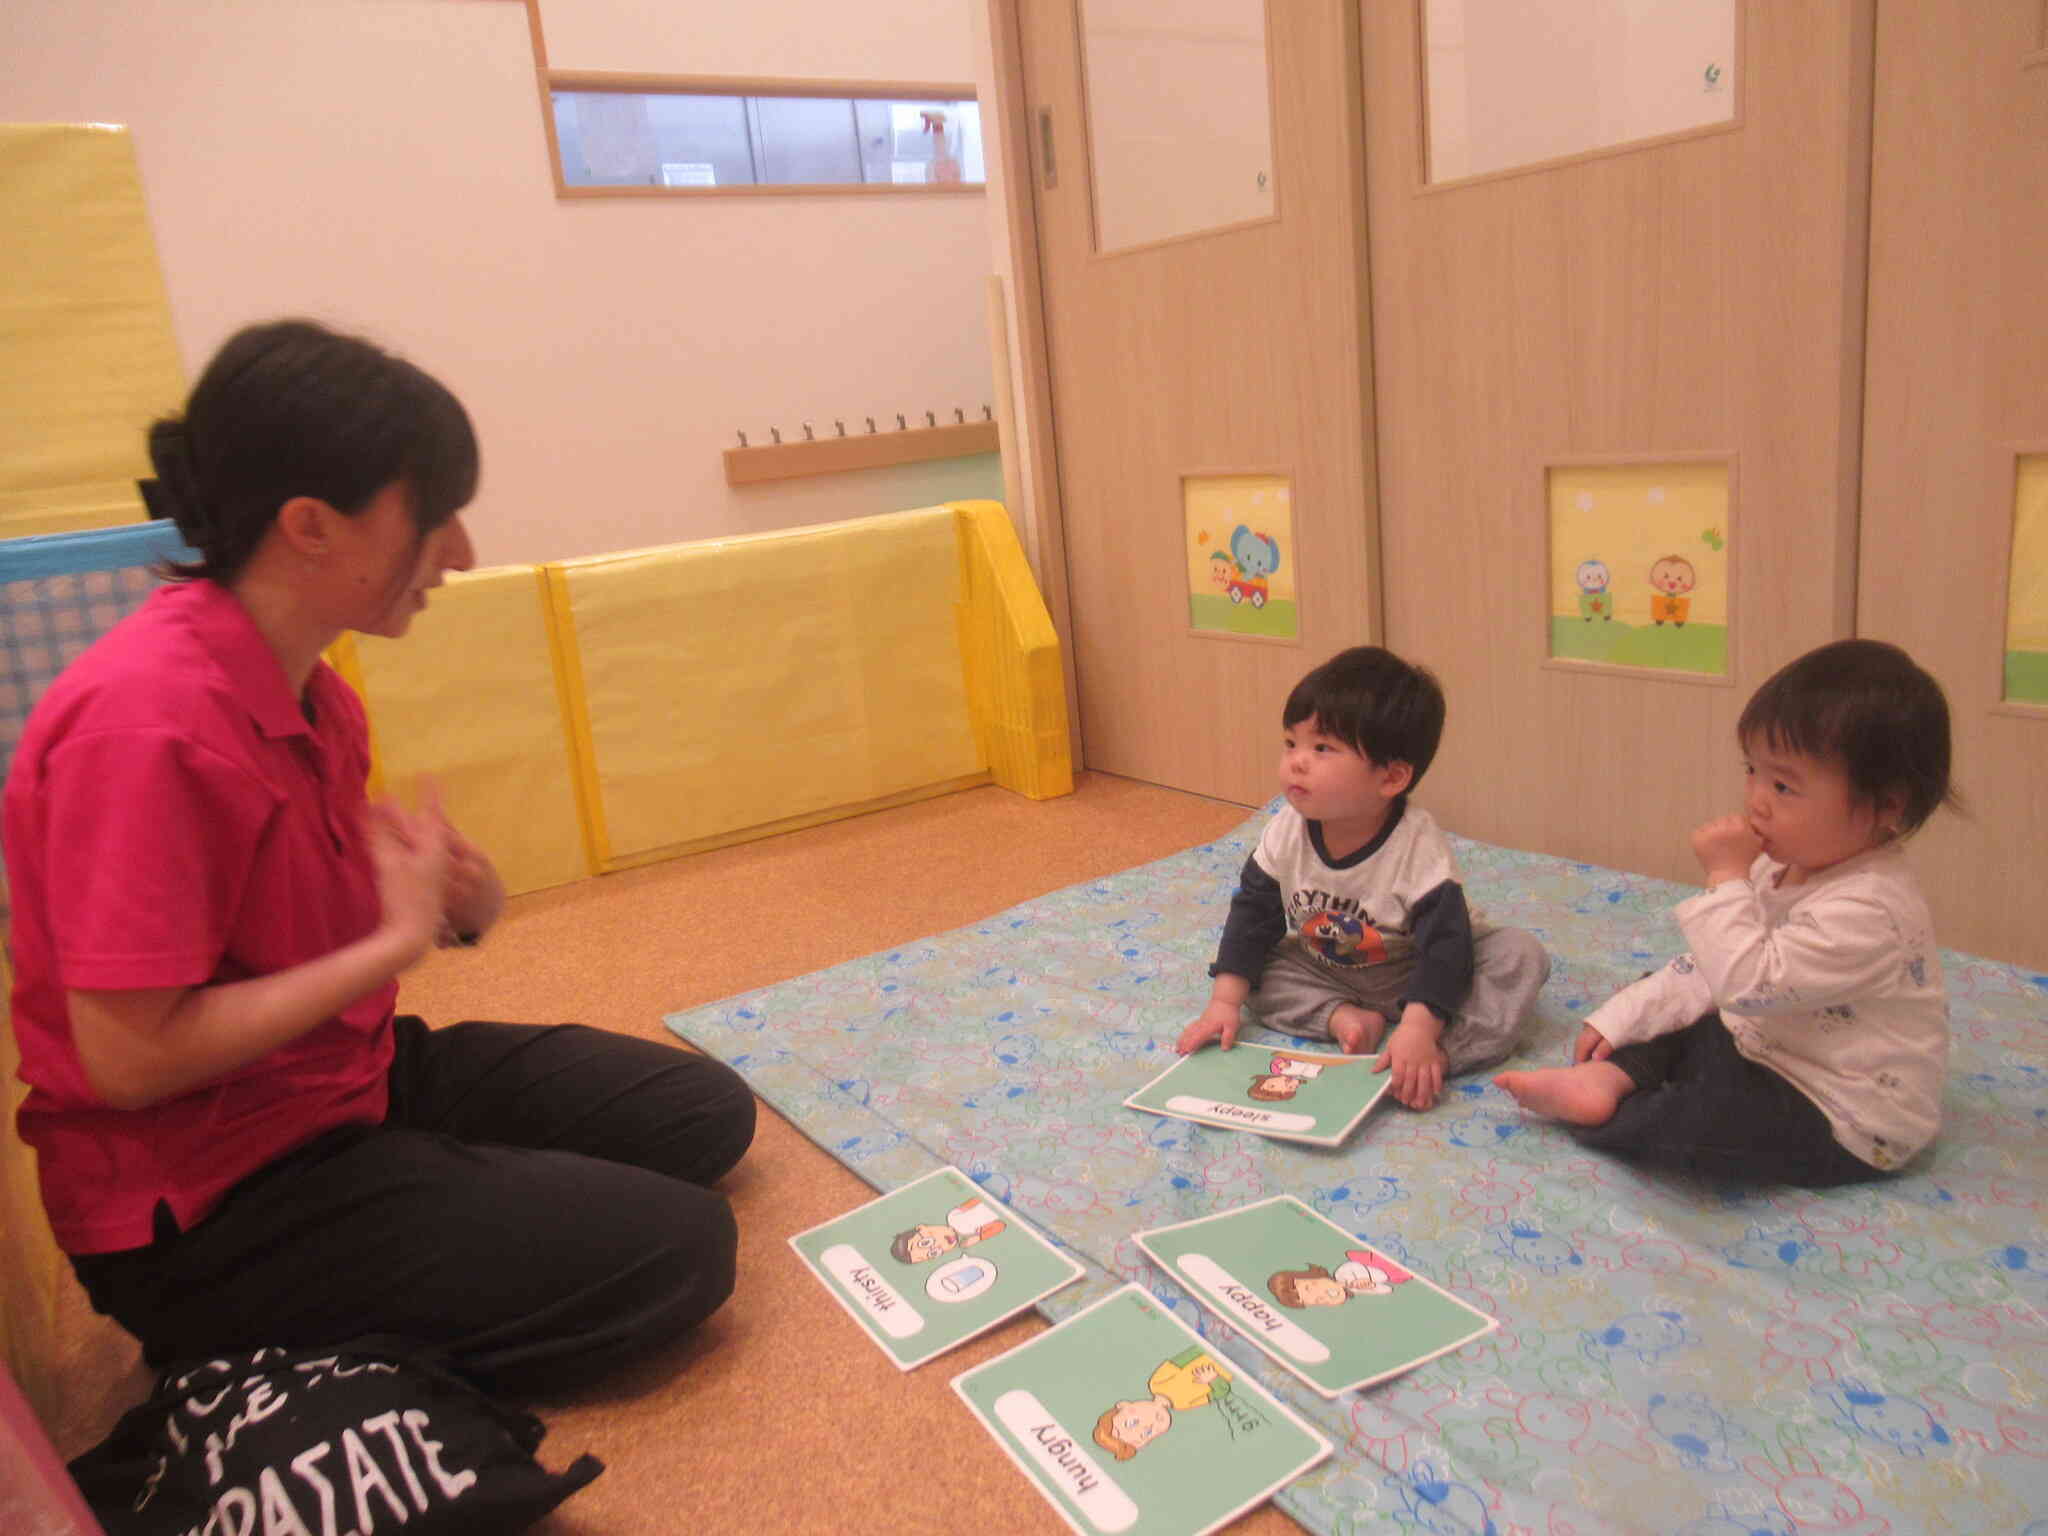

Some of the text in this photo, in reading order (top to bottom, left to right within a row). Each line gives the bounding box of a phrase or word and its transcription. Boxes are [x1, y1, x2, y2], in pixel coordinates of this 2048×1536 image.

[1208, 1102, 1271, 1123] sleepy
[850, 1265, 895, 1312] thirsty
[1218, 1284, 1283, 1332] happy
[1031, 1423, 1099, 1495] hungry
